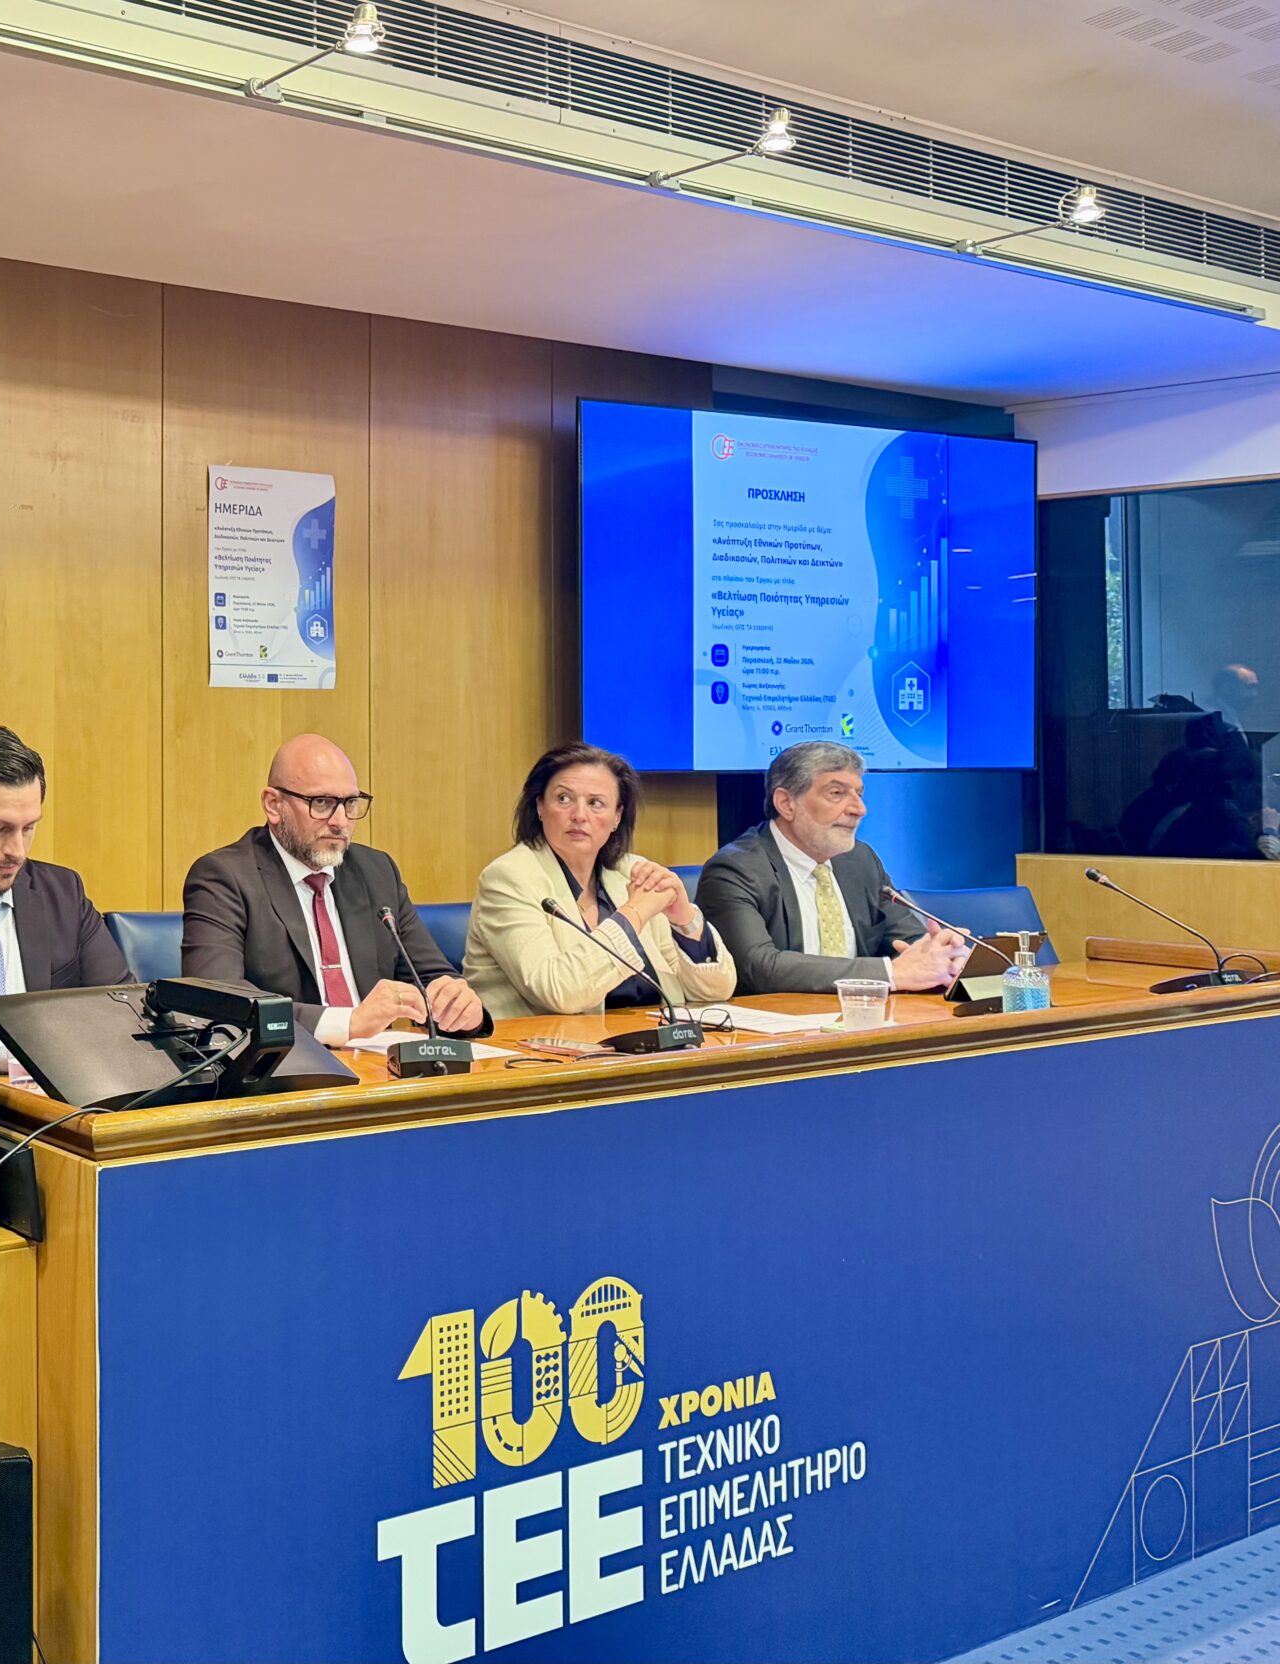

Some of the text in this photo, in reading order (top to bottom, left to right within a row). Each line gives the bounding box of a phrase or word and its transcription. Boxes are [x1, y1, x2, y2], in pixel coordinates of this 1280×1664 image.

[748, 488, 805, 502] ΠΡΟΣΚΛΗΣΗ
[214, 502, 263, 517] ΗΜΕΡΙΔΑ
[713, 519, 724, 528] Σας
[725, 521, 766, 531] προσκαλούμε
[783, 524, 807, 533] Ημερίδα
[712, 536, 823, 552] «Ανάπτυξη Εθνικών Προτύπων,
[712, 553, 843, 568] Διαδικασιών, Πολιτικών και Δεικτών»
[711, 590, 849, 607] «Βελτίωση Ποιότητας Υπηρεσιών
[711, 605, 745, 619] Υγείας»
[397, 1275, 645, 1490] 100
[657, 1370, 777, 1431] ΧΡΟΝΙΑ
[658, 1413, 782, 1485] ΤΕΧΝΙΚΟ
[659, 1440, 867, 1541] ΕΠΙΜΕΛΗΤΗΡΙΟ
[376, 1448, 644, 1664] ΤΕΕ
[660, 1513, 794, 1595] ΕΛΛΑΔΑΣ
